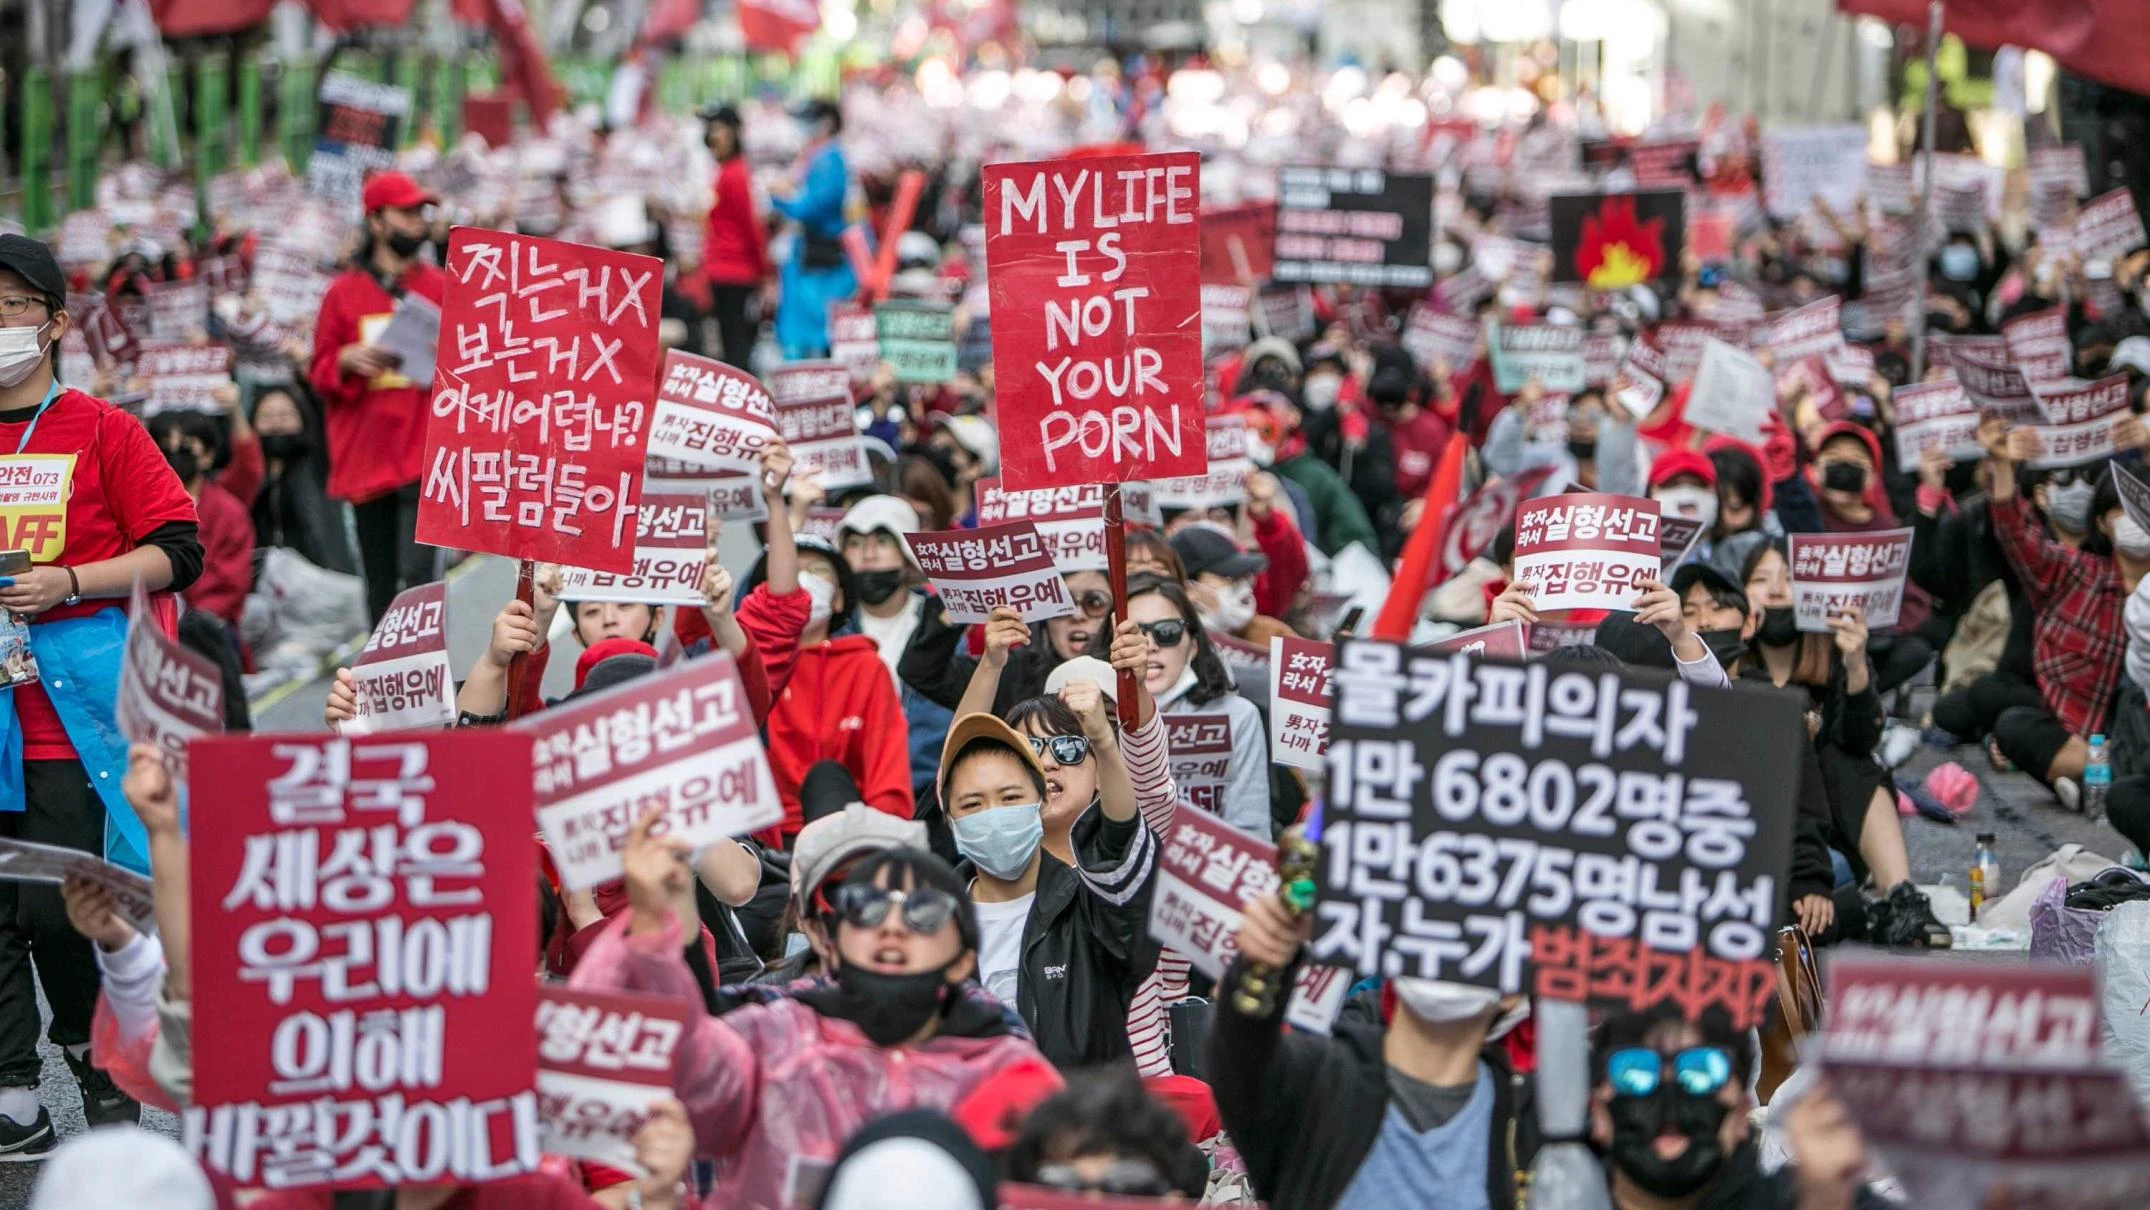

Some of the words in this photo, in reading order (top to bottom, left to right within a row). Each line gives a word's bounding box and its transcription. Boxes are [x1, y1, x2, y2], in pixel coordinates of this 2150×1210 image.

[1056, 232, 1127, 288] IS
[1045, 287, 1149, 351] NOT
[693, 370, 780, 424] 실형선
[1035, 347, 1169, 405] YOUR
[1039, 403, 1182, 473] PORN
[33, 472, 60, 485] 073
[939, 532, 1042, 572] 실형선고
[1545, 505, 1658, 543] 실형선고
[369, 663, 446, 717] 집행유예
[1282, 671, 1318, 695] 라서
[1288, 651, 1327, 674] 女자
[571, 678, 740, 782] 실형선고
[1333, 640, 1699, 765] 몰카피의자
[1164, 723, 1228, 749] 선고
[1280, 732, 1311, 752] 니까
[265, 736, 436, 827] 결국
[221, 819, 486, 914] 세상은
[236, 910, 494, 1006] 우리에
[267, 1002, 445, 1096] 의해
